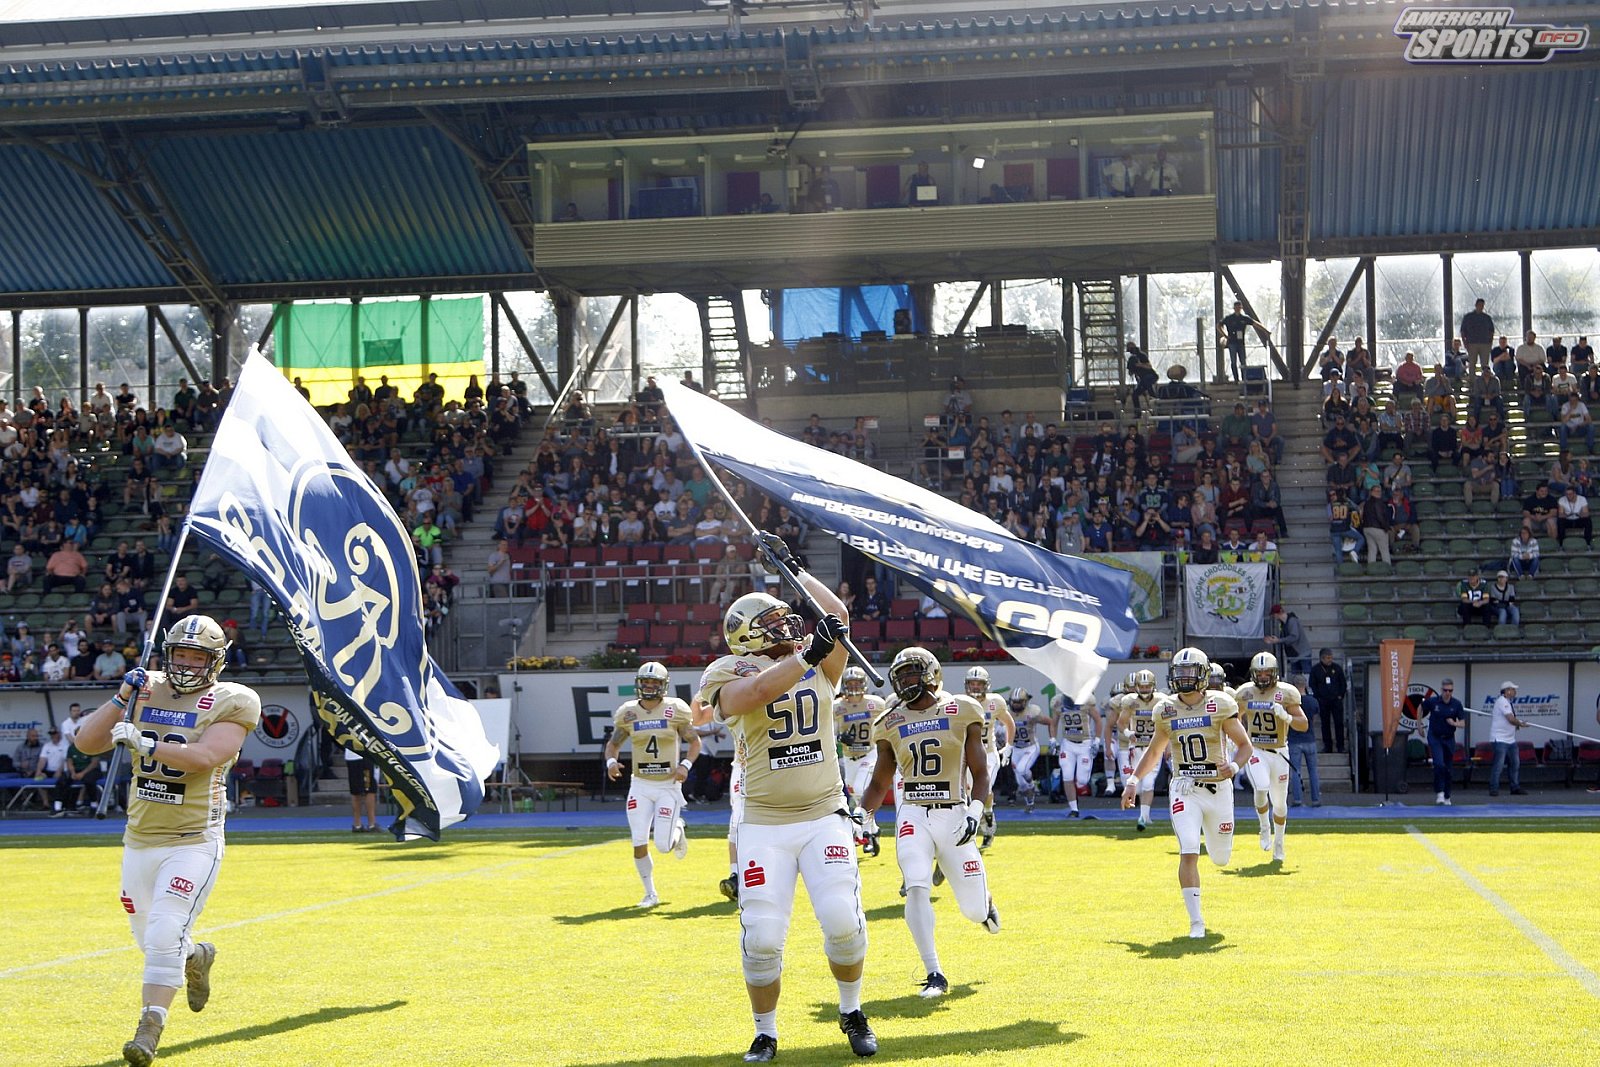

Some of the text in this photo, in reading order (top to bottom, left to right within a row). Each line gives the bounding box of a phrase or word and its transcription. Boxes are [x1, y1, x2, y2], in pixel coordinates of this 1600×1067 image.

[1467, 589, 1482, 600] 12
[1391, 650, 1400, 708] STETSON
[149, 714, 186, 726] DRESDEN
[151, 708, 187, 720] ELBEPARK
[766, 688, 820, 741] 50
[907, 719, 940, 730] ELBEPARK
[1177, 717, 1203, 725] ELBEPARK
[1252, 711, 1277, 732] 49
[848, 721, 870, 740] 46
[907, 724, 941, 735] DRESDEN
[645, 734, 659, 759] 4
[786, 744, 811, 755] Jeep
[1178, 733, 1208, 763] 10
[909, 738, 942, 777] 16
[144, 780, 168, 793] Jeep
[915, 783, 937, 791] Jeep
[825, 847, 848, 856] KNS
[171, 878, 193, 893] KNS
